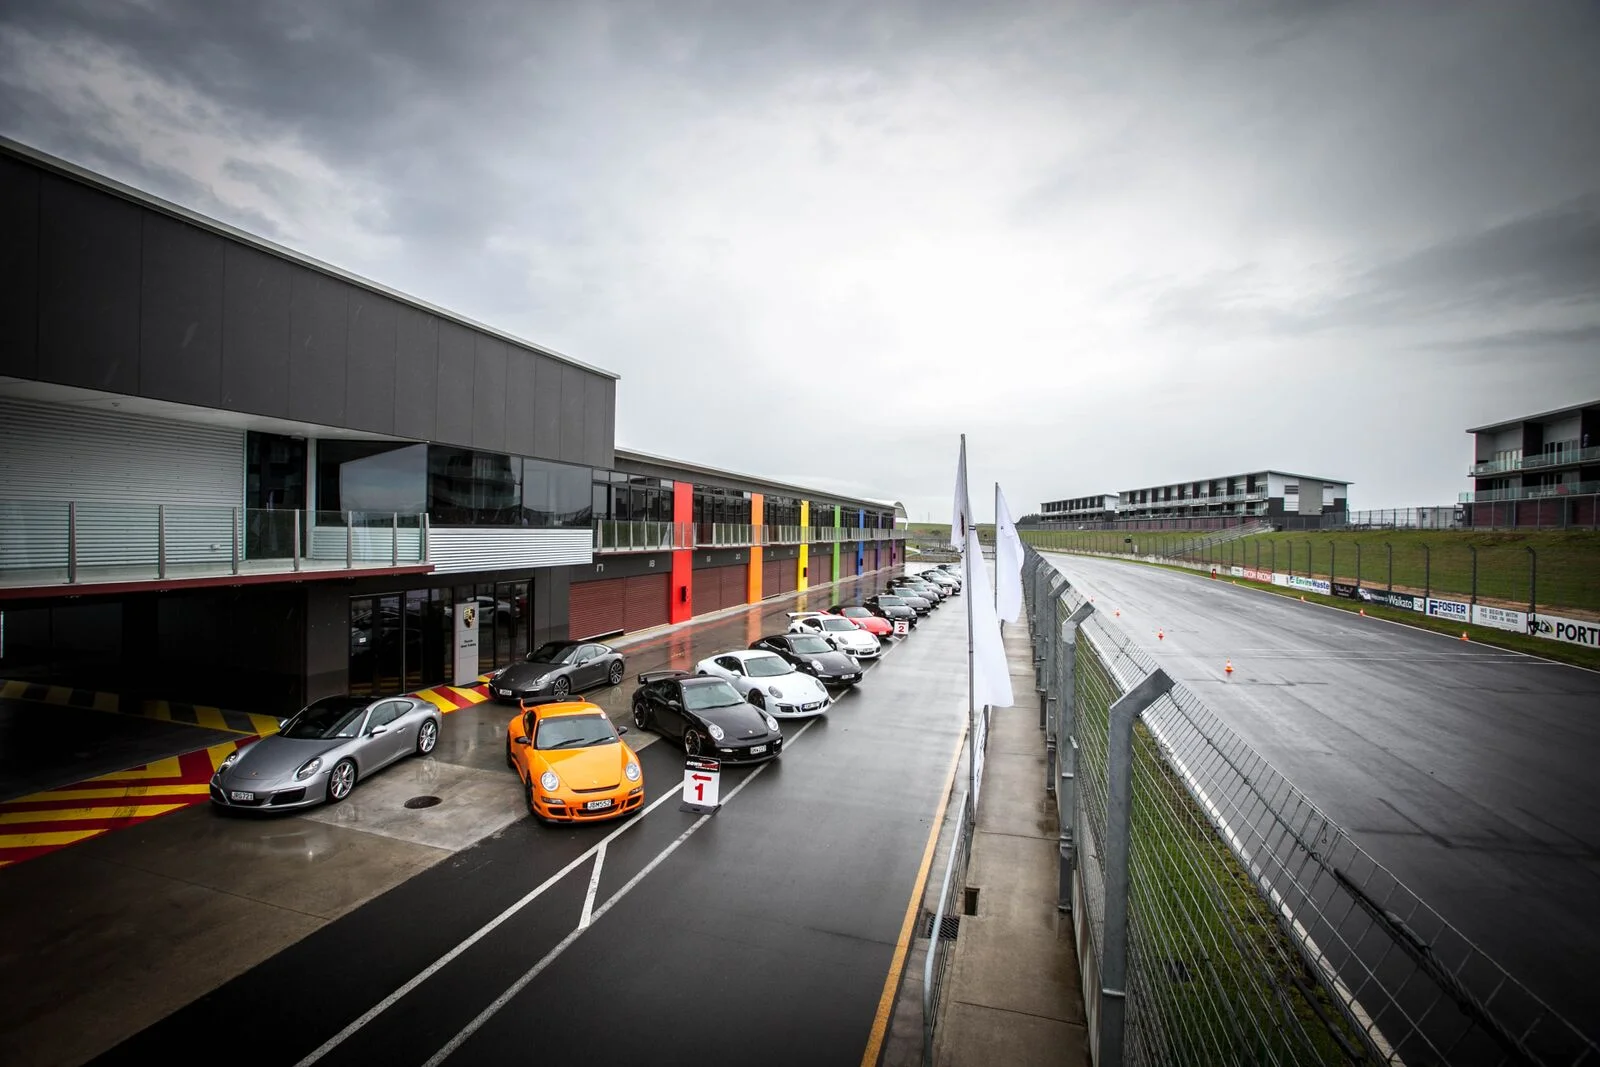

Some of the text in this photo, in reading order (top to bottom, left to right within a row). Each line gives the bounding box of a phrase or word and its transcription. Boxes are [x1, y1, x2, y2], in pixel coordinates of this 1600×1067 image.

[1296, 577, 1330, 590] EnviroWaste
[1388, 595, 1413, 609] Waikato
[1438, 602, 1466, 614] FOSTER
[1438, 612, 1466, 621] CONSTRUCTION
[898, 625, 905, 633] 2
[1556, 621, 1600, 647] PORT
[695, 783, 703, 801] 1
